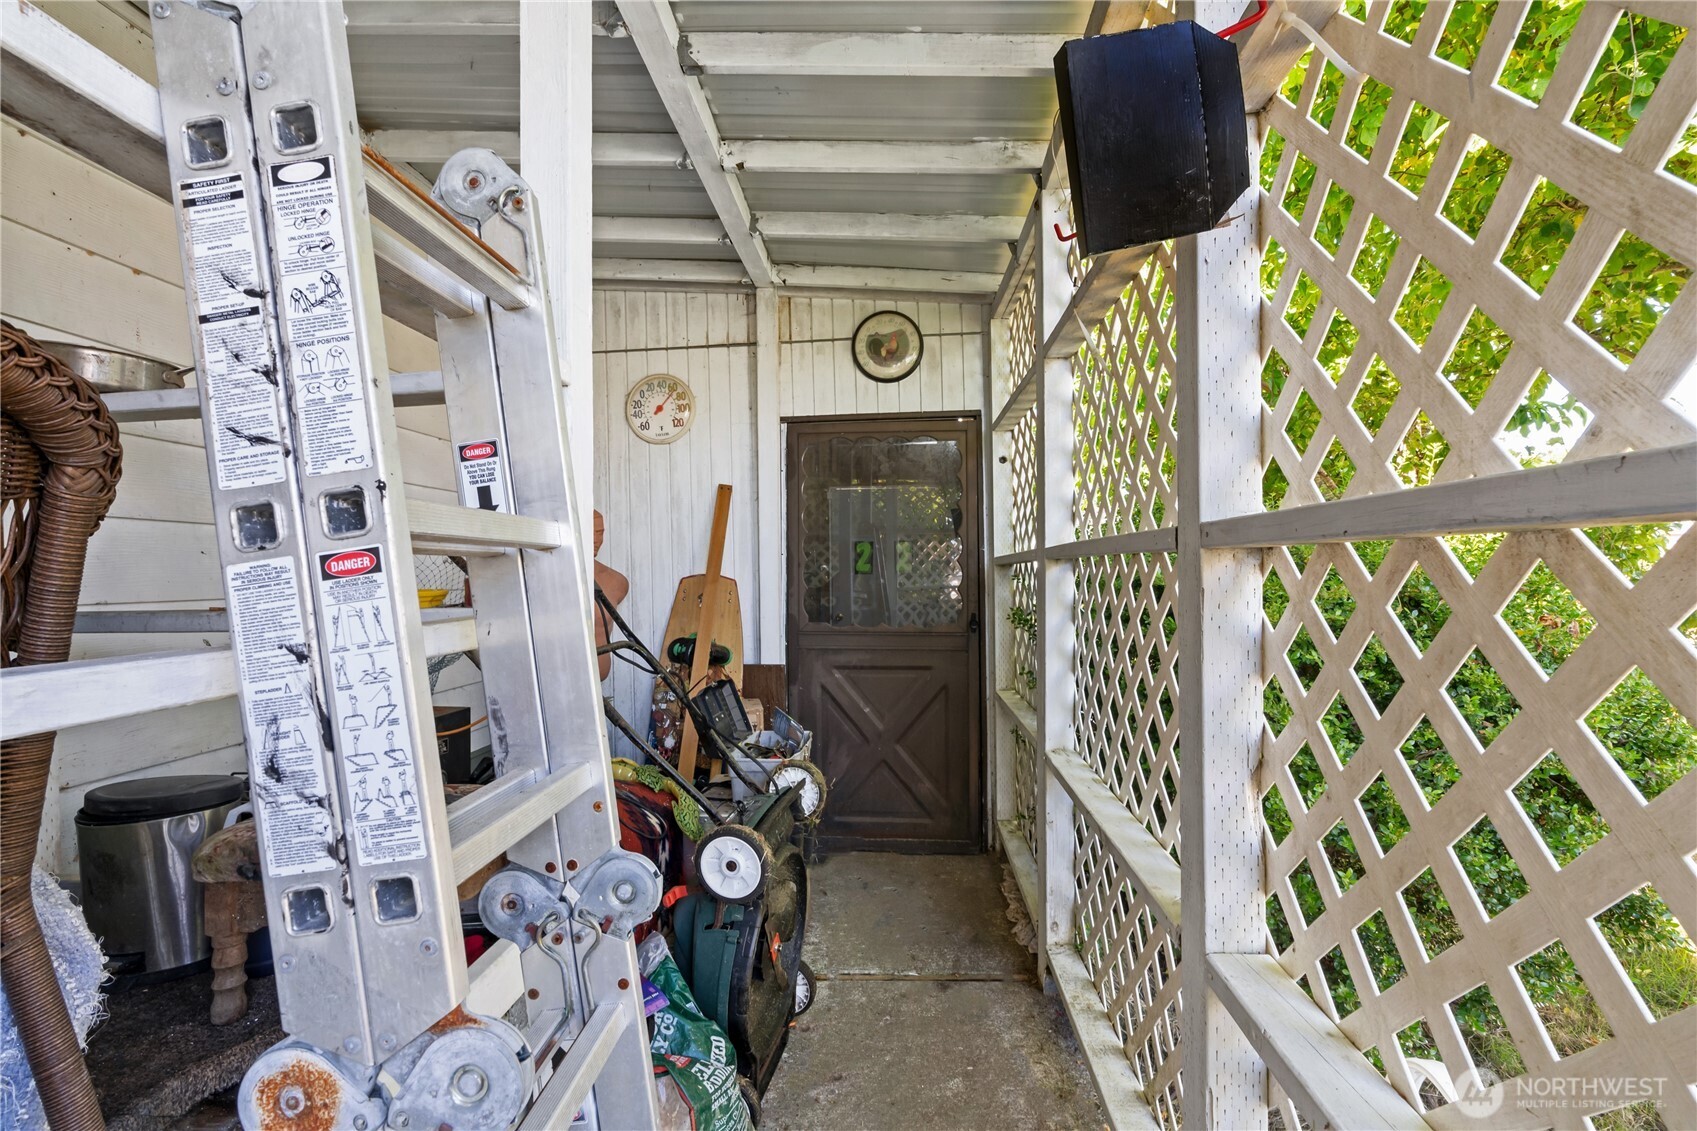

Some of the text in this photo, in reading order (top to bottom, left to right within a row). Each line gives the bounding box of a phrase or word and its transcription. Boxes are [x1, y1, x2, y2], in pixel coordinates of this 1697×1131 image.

[188, 187, 217, 196] ARTICULATED
[297, 198, 333, 208] OPERATION
[317, 335, 350, 345] POSITIONS
[646, 383, 654, 391] 20
[657, 381, 666, 389] 40
[668, 383, 677, 391] 60
[640, 390, 644, 398] 0
[676, 392, 686, 400] 80
[638, 422, 650, 430] -60
[672, 418, 684, 427] 120
[466, 447, 491, 456] DANGER
[856, 543, 871, 572] 2
[331, 556, 370, 572] DANGER
[231, 573, 263, 581] INSTRUCTIONS
